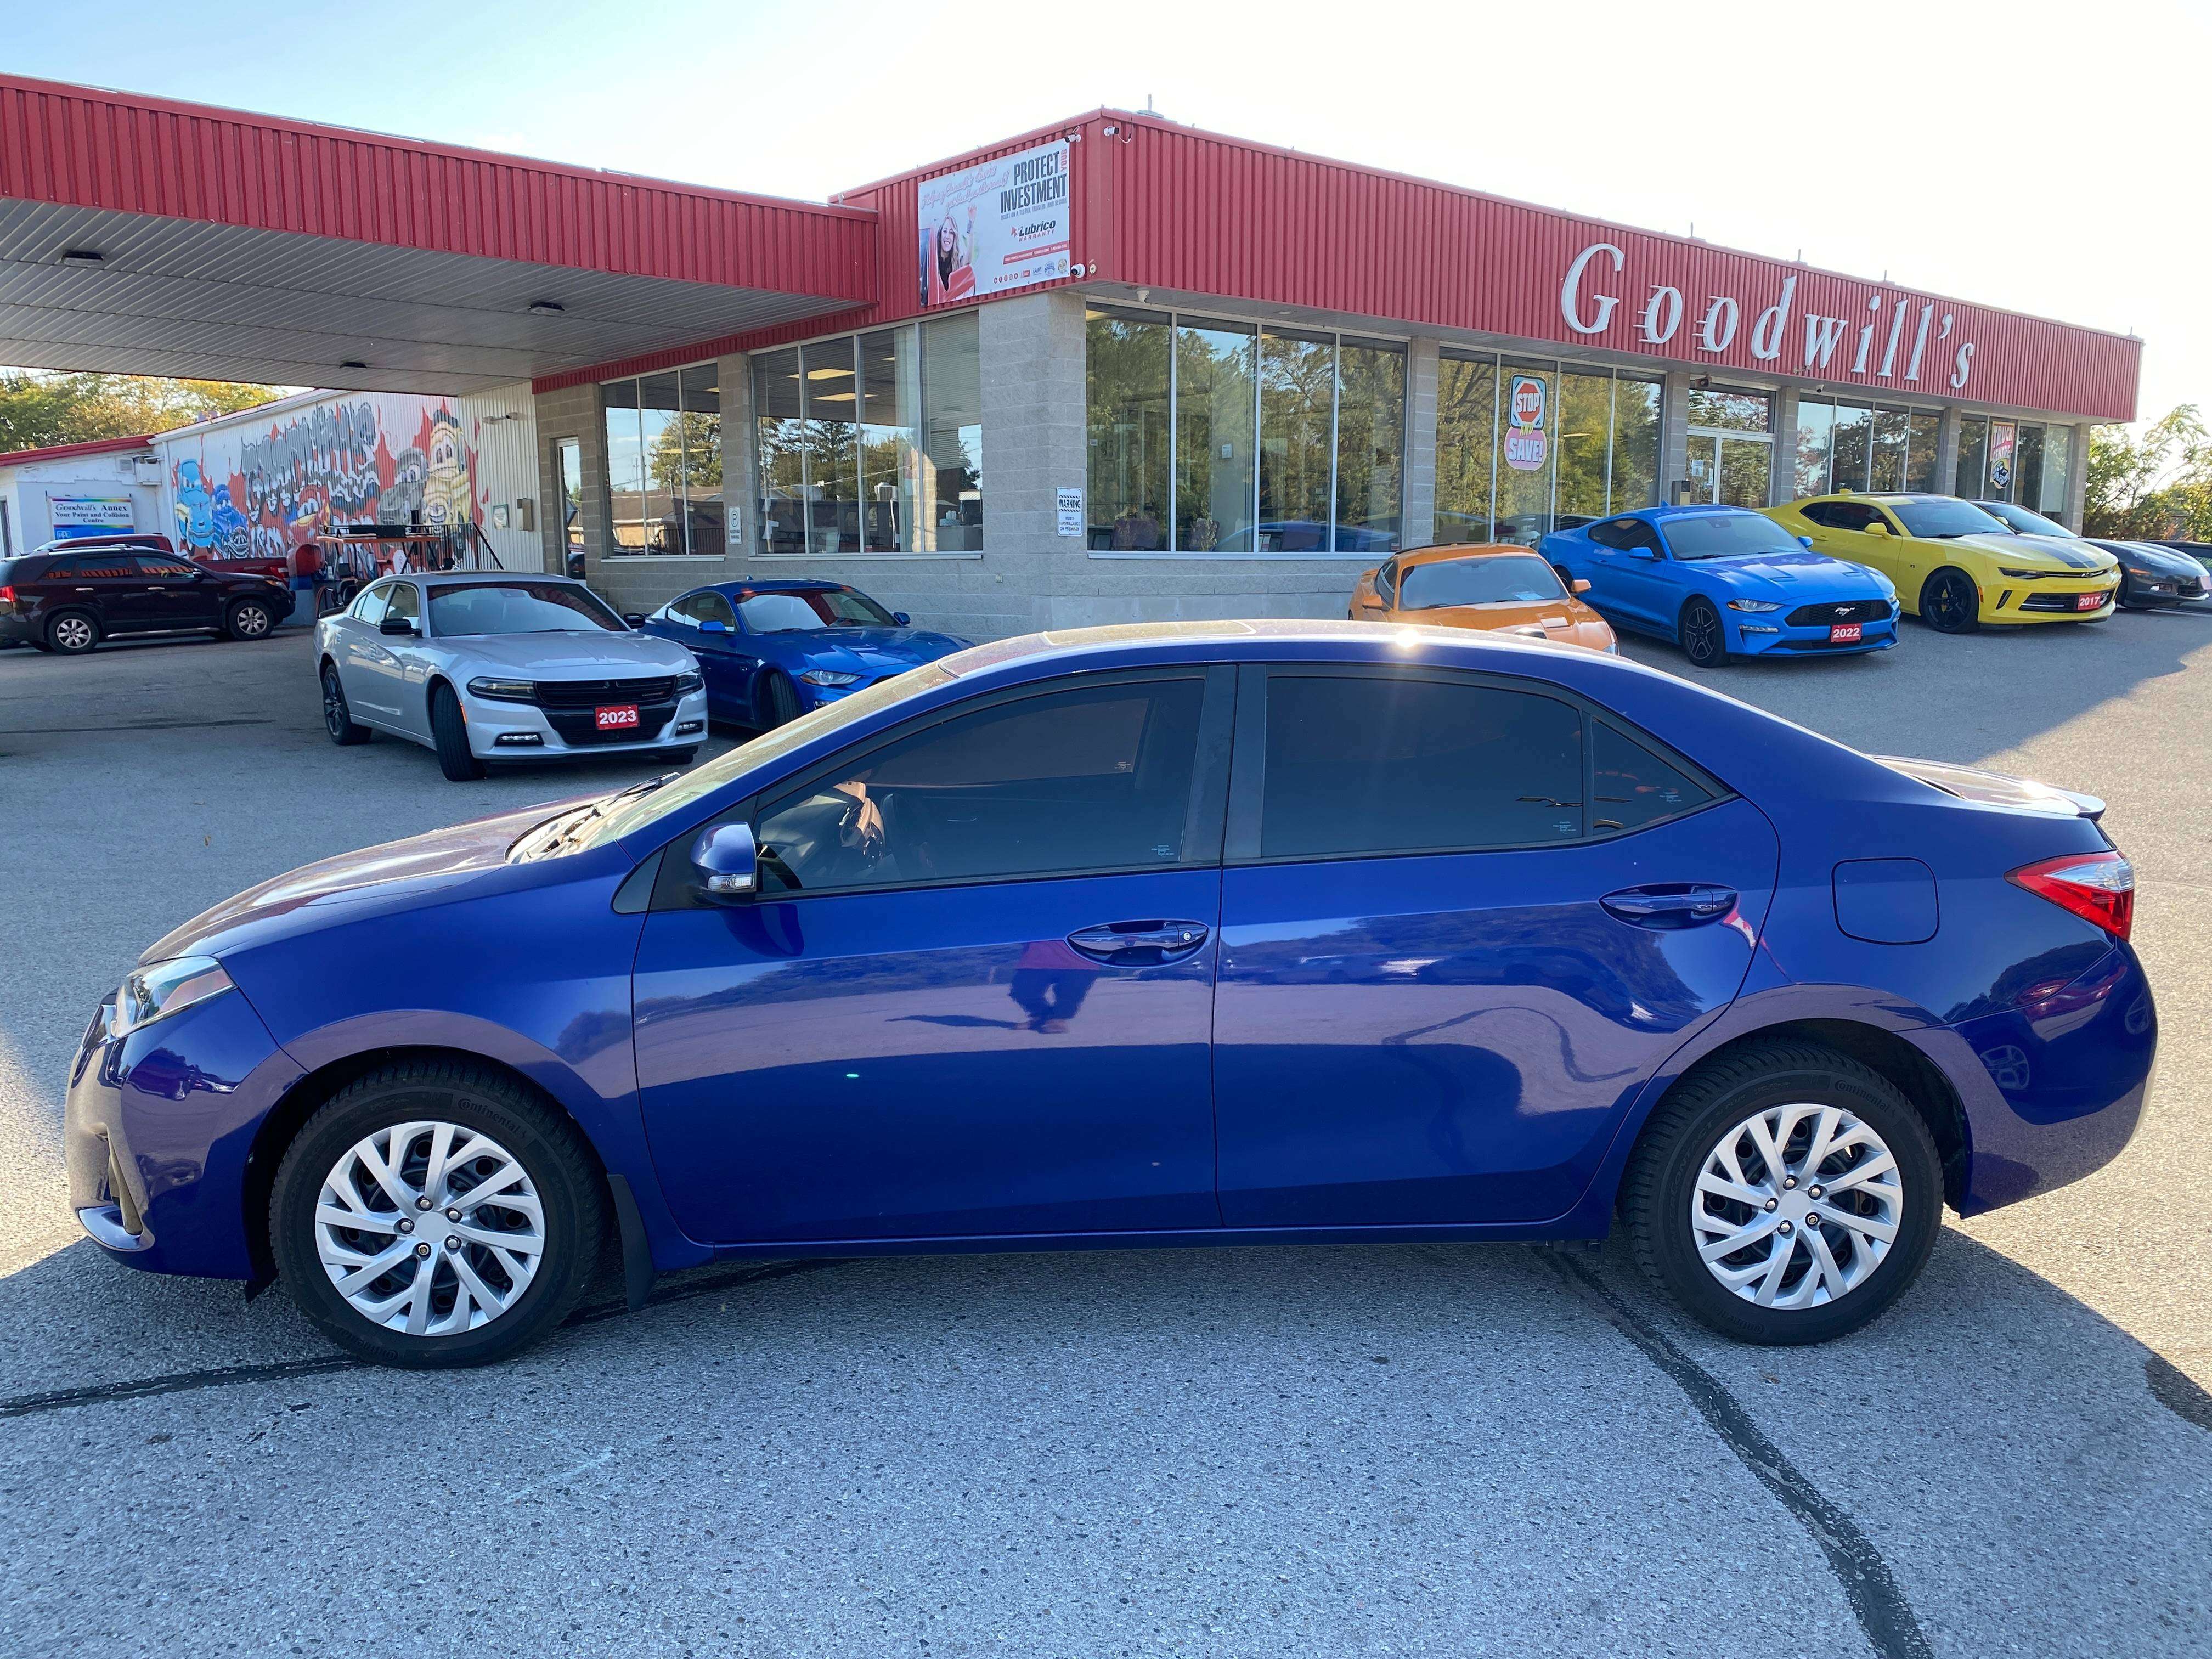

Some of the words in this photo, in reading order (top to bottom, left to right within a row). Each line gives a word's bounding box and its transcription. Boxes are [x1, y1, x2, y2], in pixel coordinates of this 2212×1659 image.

[1014, 151, 1059, 185] PROTECT
[1000, 174, 1067, 213] INVESTMENT
[1018, 229, 1055, 242] WARRANTY
[1019, 220, 1056, 237] Lubrico
[1560, 242, 1975, 390] Goodwill's
[1516, 393, 1541, 413] STOP
[1520, 425, 1533, 436] AND
[1993, 425, 2013, 448] TRUCK
[1509, 437, 1543, 464] SAVE!
[1059, 499, 1080, 509] WARNING
[2079, 597, 2099, 606] 2017
[1832, 627, 1860, 639] 2022
[599, 709, 636, 724] 2023
[1835, 1079, 1889, 1113] Continental
[458, 1098, 519, 1133] Continental
